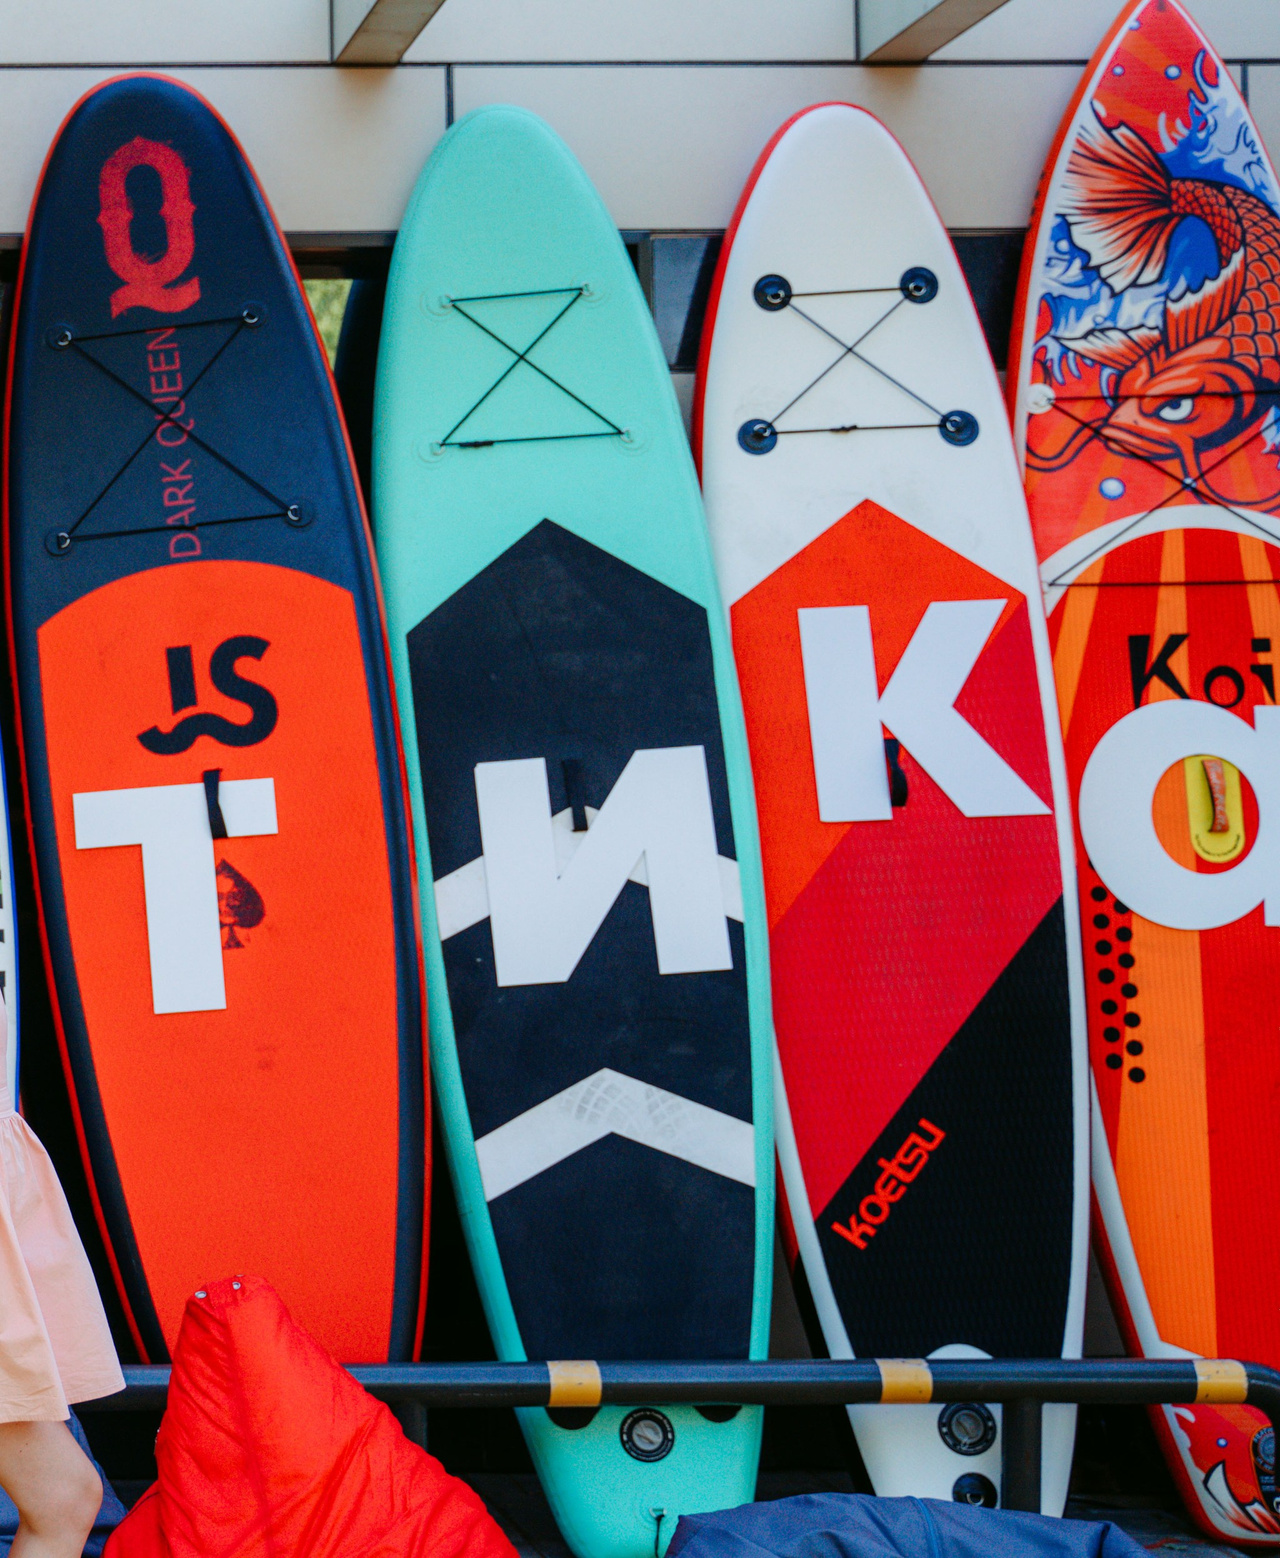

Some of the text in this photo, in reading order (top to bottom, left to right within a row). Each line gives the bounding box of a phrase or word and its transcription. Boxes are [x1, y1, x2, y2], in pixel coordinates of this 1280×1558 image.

[96, 135, 202, 319] Q
[147, 327, 203, 558] DARK QUEEN
[1128, 633, 1278, 709] Koi
[831, 1118, 947, 1250] koetsu
